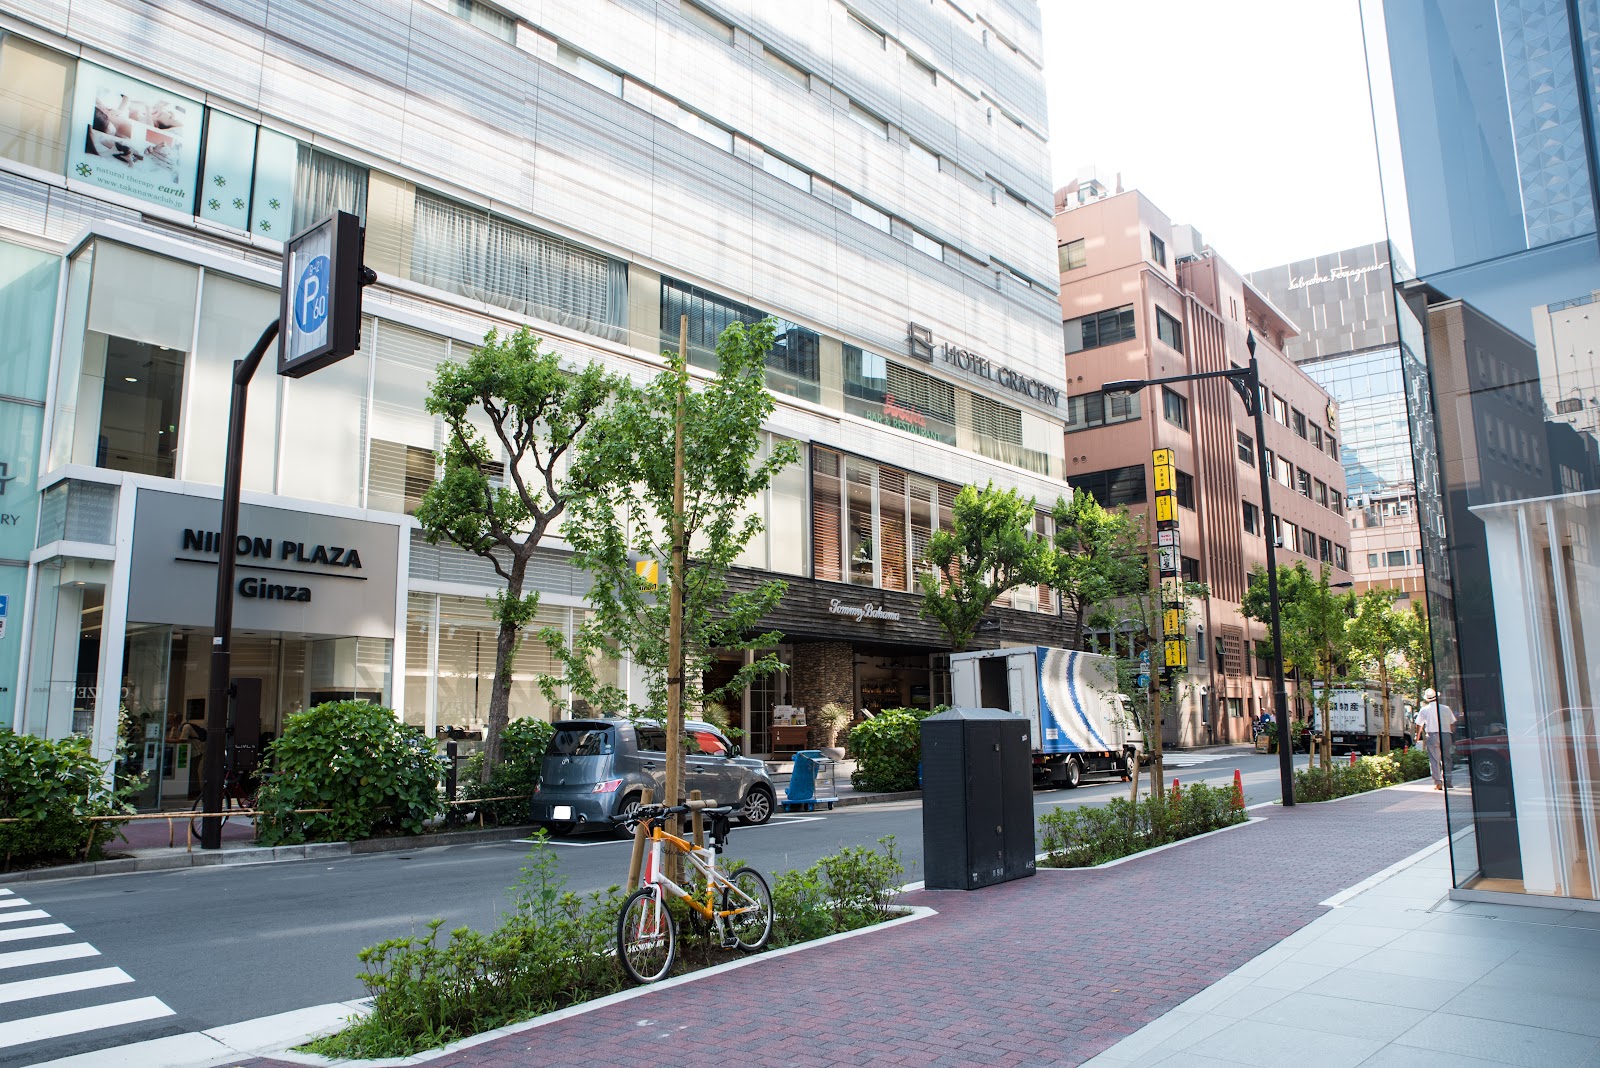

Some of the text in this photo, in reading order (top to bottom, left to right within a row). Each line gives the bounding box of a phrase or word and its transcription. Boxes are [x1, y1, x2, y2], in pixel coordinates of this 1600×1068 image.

[96, 165, 186, 198] natural therapy earth
[302, 275, 320, 325] P
[313, 295, 326, 320] 60
[943, 342, 1061, 408] HOTEL GRACERY
[866, 410, 941, 442] BAR & RESTAURANT
[183, 528, 362, 568] NION PLAZA
[238, 577, 311, 602] Ginza
[829, 598, 900, 622] Tommy Bahama
